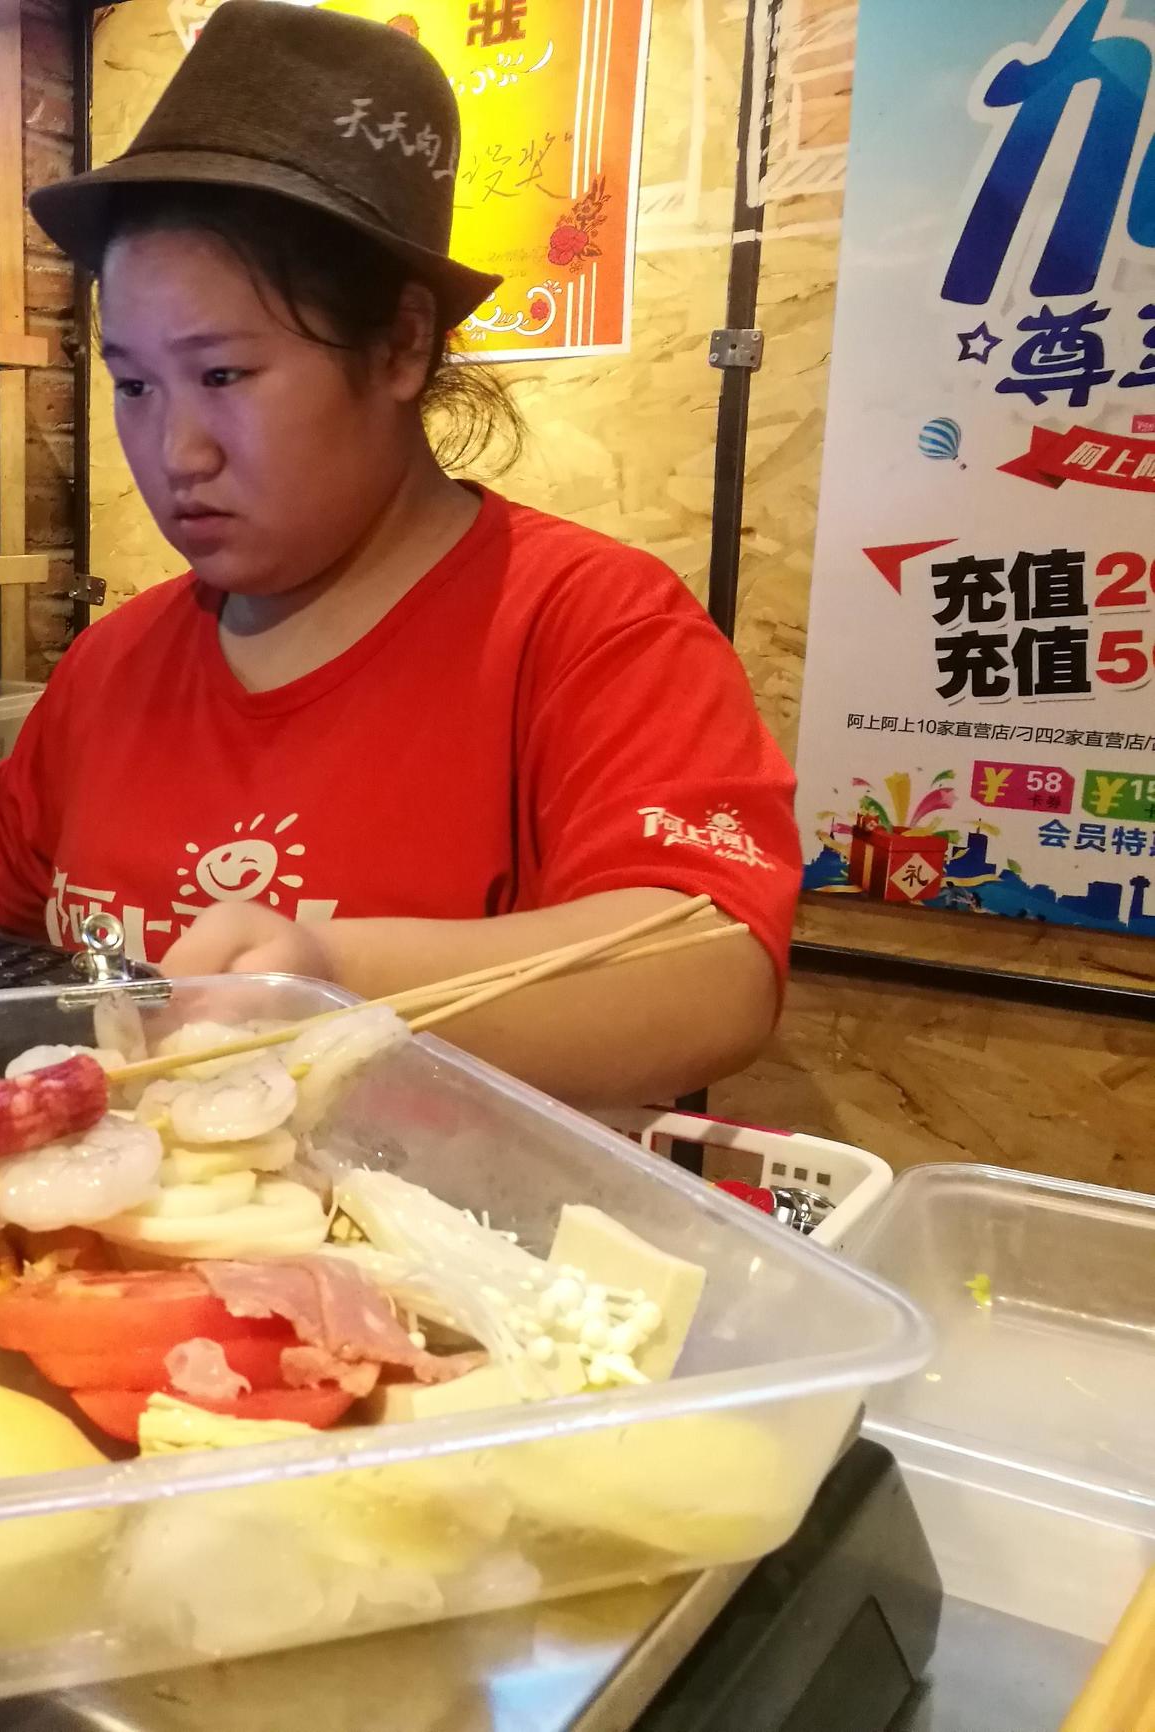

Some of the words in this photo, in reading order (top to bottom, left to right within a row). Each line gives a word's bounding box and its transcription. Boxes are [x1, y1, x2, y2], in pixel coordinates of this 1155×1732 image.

[931, 549, 1155, 625] 充值2
[935, 625, 1155, 699] 充值5
[1037, 818, 1155, 857] 会员特
[902, 864, 928, 888] 礼
